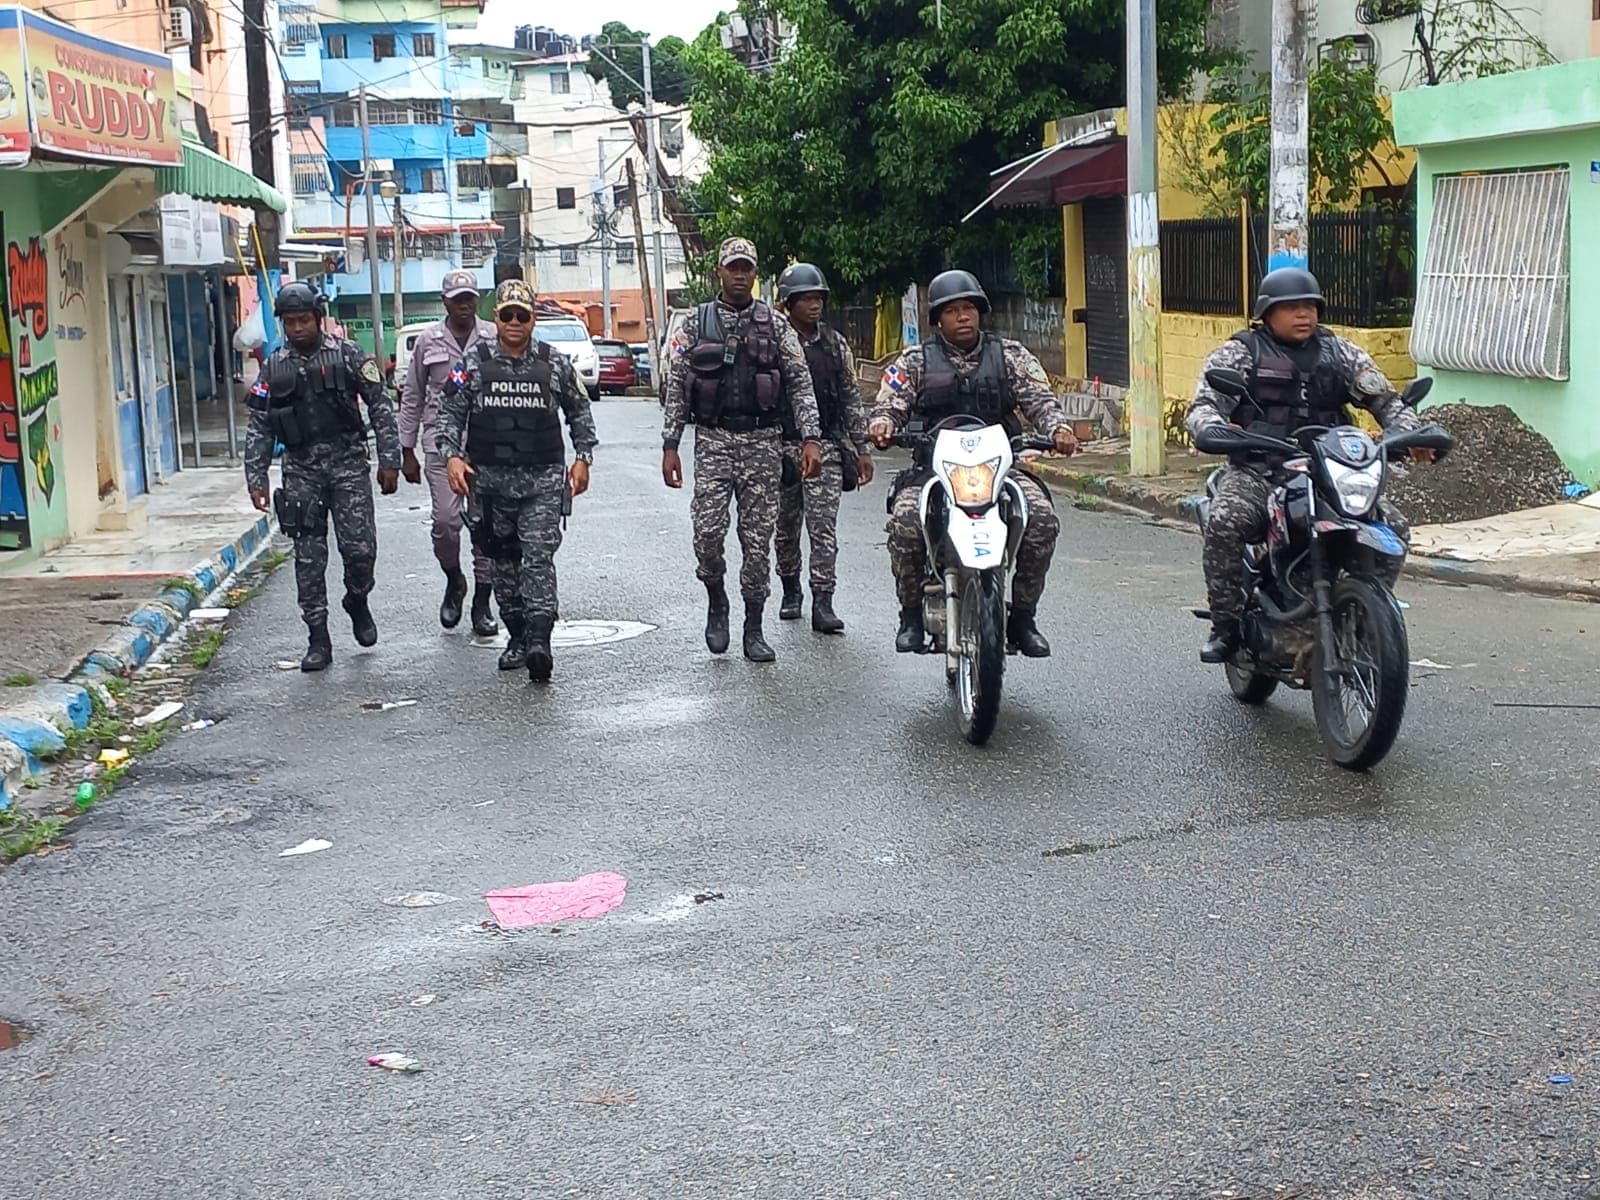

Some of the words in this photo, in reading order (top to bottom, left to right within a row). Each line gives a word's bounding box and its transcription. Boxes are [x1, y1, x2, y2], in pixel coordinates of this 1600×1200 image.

[47, 70, 166, 142] RUDDY
[491, 382, 541, 393] POLICIA
[484, 395, 547, 408] NACIONAL
